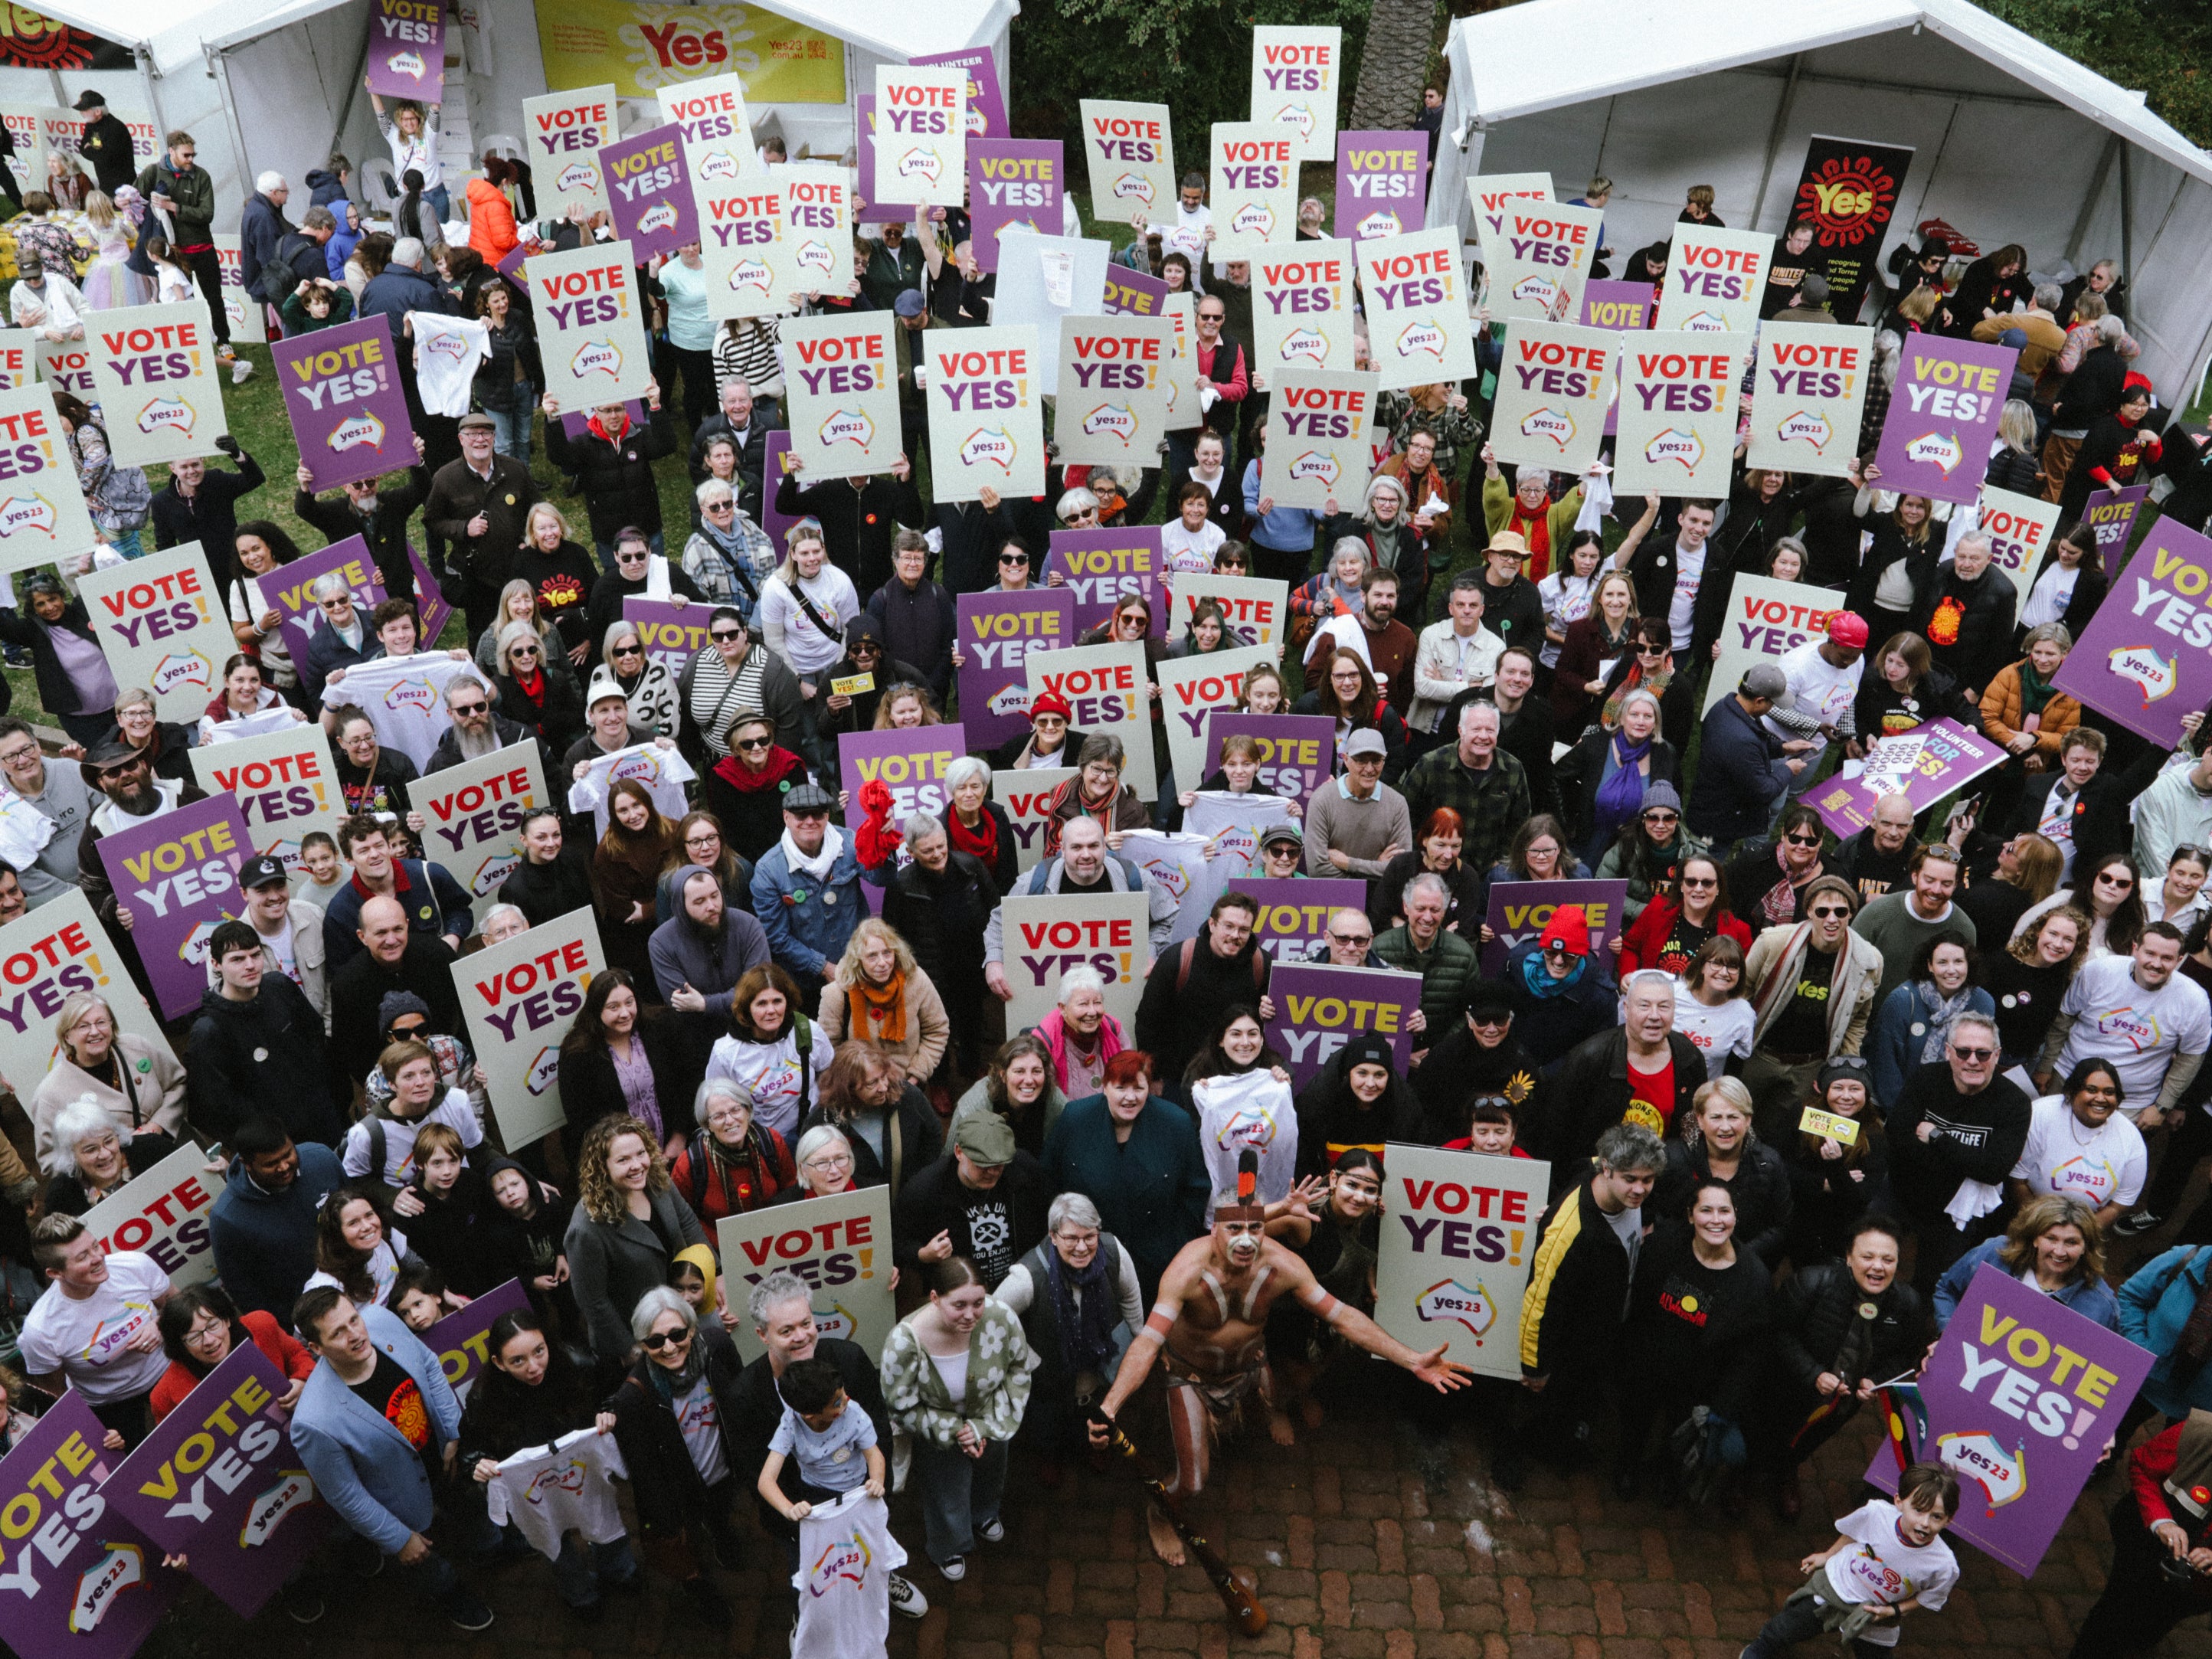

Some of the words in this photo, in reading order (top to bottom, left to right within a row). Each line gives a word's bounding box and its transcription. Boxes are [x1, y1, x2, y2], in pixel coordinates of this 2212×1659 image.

[383, 0, 439, 23] VOTE
[379, 16, 438, 45] YES!
[639, 22, 728, 68] Yes
[769, 41, 802, 51] Yes23
[1264, 46, 1330, 64] VOTE
[396, 60, 417, 68] yes23
[1263, 70, 1327, 91] YES!
[670, 92, 736, 120] VOTE
[888, 87, 955, 107] VOTE
[536, 104, 607, 130] VOTE
[680, 114, 741, 143] YES!
[887, 110, 955, 135] YES!
[1094, 118, 1161, 139] VOTE
[538, 126, 608, 154] YES!
[1095, 139, 1162, 163] YES!
[1223, 142, 1290, 162] VOTE
[612, 141, 676, 178] VOTE
[707, 159, 731, 171] yes23
[908, 159, 934, 169] yes23
[980, 159, 1053, 180] VOTE
[1348, 150, 1418, 171] VOTE
[565, 170, 592, 183] yes23
[616, 165, 681, 201] YES!
[1122, 182, 1147, 191] yes23
[1222, 165, 1288, 189] YES!
[1347, 175, 1415, 198] YES!
[980, 182, 1052, 207] YES!
[1815, 185, 1872, 214] Yes
[646, 211, 670, 224] yes23
[708, 195, 780, 220] VOTE
[1242, 213, 1266, 224] yes23
[711, 220, 781, 247] YES!
[1177, 233, 1197, 241] yes23
[1367, 222, 1392, 231] yes23
[1515, 216, 1588, 244] VOTE
[805, 249, 827, 260] yes23
[1372, 250, 1450, 280] VOTE
[1510, 238, 1582, 269] YES!
[1683, 244, 1759, 274] VOTE
[1828, 259, 1860, 267] recognise
[542, 265, 624, 299] VOTE
[738, 269, 764, 280] yes23
[1263, 261, 1340, 286] VOTE
[1679, 270, 1753, 301] YES!
[1265, 286, 1340, 314] YES!
[1375, 276, 1454, 309] YES!
[1523, 285, 1551, 296] yes23
[546, 293, 629, 329] YES!
[1589, 302, 1643, 327] VOTE
[1692, 321, 1721, 331] yes23
[101, 324, 198, 355] VOTE
[436, 341, 460, 352] yes23
[797, 335, 883, 364] VOTE
[1074, 337, 1160, 360] VOTE
[1291, 340, 1320, 350] yes23
[1408, 333, 1436, 345] yes23
[290, 339, 383, 381] VOTE
[582, 352, 612, 365] yes23
[939, 350, 1026, 378] VOTE
[1519, 340, 1605, 371] VOTE
[1638, 355, 1729, 379] VOTE
[1772, 343, 1858, 370] VOTE
[106, 352, 203, 385] YES!
[799, 363, 884, 395] YES!
[1072, 363, 1157, 389] YES!
[1914, 356, 2000, 392] VOTE
[297, 364, 389, 411] YES!
[1515, 365, 1601, 399] YES!
[1770, 368, 1855, 399] YES!
[941, 379, 1027, 411] YES!
[1284, 388, 1363, 412] VOTE
[1635, 383, 1726, 413] YES!
[1906, 384, 1993, 424] YES!
[149, 408, 184, 420] yes23
[1095, 415, 1127, 426] yes23
[1281, 412, 1360, 439] YES!
[1533, 418, 1565, 430] yes23
[340, 424, 372, 441] yes23
[831, 421, 863, 433] yes23
[1790, 423, 1822, 434] yes23
[973, 441, 1005, 453] yes23
[1659, 441, 1693, 453] yes23
[1919, 443, 1951, 457] yes23
[2119, 452, 2138, 466] Yes
[1301, 461, 1331, 472] yes23
[6, 506, 44, 524] yes23
[2089, 502, 2135, 525] VOTE
[1982, 509, 2043, 545] VOTE
[1065, 548, 1150, 574] VOTE
[1179, 558, 1204, 568] yes23
[101, 568, 201, 617] VOTE
[544, 588, 576, 607] Yes
[1065, 577, 1152, 605] YES!
[111, 595, 211, 648] YES!
[971, 610, 1060, 637] VOTE
[1743, 596, 1826, 633] VOTE
[164, 662, 199, 681] yes23
[1042, 666, 1134, 694] VOTE
[2123, 653, 2164, 684] yes23
[396, 689, 427, 701] yes23
[1830, 692, 1853, 706] yes23
[1924, 737, 1961, 762] FOR
[1930, 724, 1985, 759] VOLUNTEER
[212, 752, 320, 792] VOTE
[618, 762, 649, 777] yes23
[856, 751, 954, 784] VOTE
[429, 767, 531, 820] VOTE
[123, 820, 236, 884] VOTE
[1222, 838, 1252, 849] yes23
[134, 852, 243, 918] YES!
[1150, 869, 1179, 882] yes23
[1020, 920, 1131, 951] VOTE
[475, 940, 587, 1007] VOTE
[0, 953, 110, 1034] YES!
[1798, 980, 1828, 1000] Yes
[1286, 996, 1401, 1032] VOTE
[2112, 1016, 2149, 1037] yes23
[1683, 1030, 1712, 1047] Yes
[761, 1073, 794, 1095] yes23
[1628, 1103, 1652, 1115] NIONS
[1811, 1112, 1831, 1123] VOTE
[1230, 1123, 1264, 1140] yes23
[1808, 1120, 1829, 1132] YES!
[2066, 1170, 2105, 1187] yes23
[1402, 1179, 1528, 1222] VOTE
[740, 1216, 872, 1267] VOTE
[988, 1246, 1011, 1257] ENJOY
[1399, 1216, 1524, 1266] YES!
[1434, 1296, 1481, 1314] yes23
[100, 1317, 142, 1353] yes23
[1979, 1304, 2119, 1408] VOTE
[1959, 1342, 2097, 1451] YES!
[139, 1376, 272, 1500] VOTE
[1959, 1444, 2009, 1481] yes23
[254, 1484, 299, 1530] yes23
[824, 1553, 859, 1579] yes23
[1856, 1561, 1900, 1595] yes23
[83, 1559, 127, 1613] yes23
